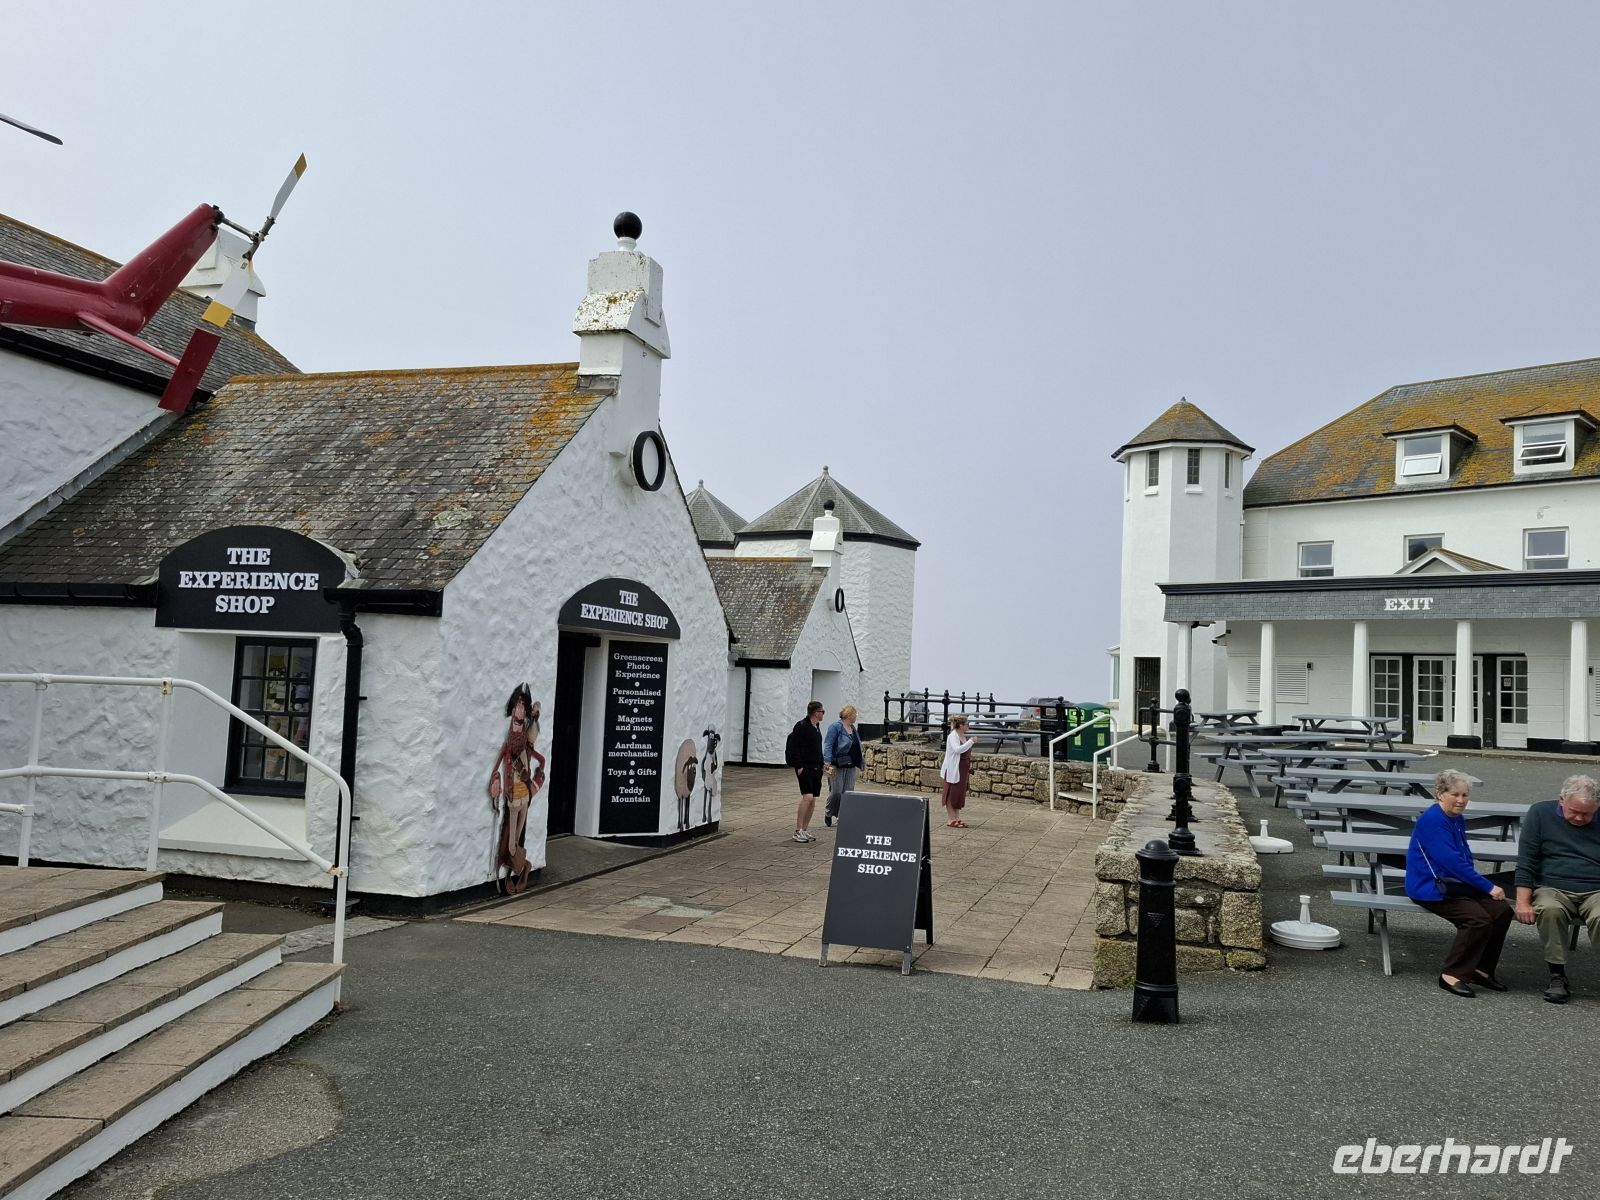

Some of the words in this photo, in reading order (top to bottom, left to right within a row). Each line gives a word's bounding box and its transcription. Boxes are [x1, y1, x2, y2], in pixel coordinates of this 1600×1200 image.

[227, 547, 271, 565] THE
[178, 571, 319, 590] EXPERIENCE
[619, 590, 639, 606] THE
[215, 595, 275, 613] SHOP
[1384, 597, 1434, 611] EXIT
[580, 603, 644, 626] EXPERIENCE
[644, 613, 669, 630] SHOP
[613, 653, 663, 662] Greenscreen
[626, 662, 650, 670] Photo
[615, 670, 660, 679] Experience
[612, 688, 662, 696] Personalised
[618, 697, 655, 706] Keyrings
[617, 715, 652, 724] Magnets
[608, 768, 627, 777] Toys
[619, 787, 643, 795] Teddy
[865, 835, 892, 846] THE
[837, 847, 917, 863] EXPERIENCE
[857, 864, 892, 875] SHOP
